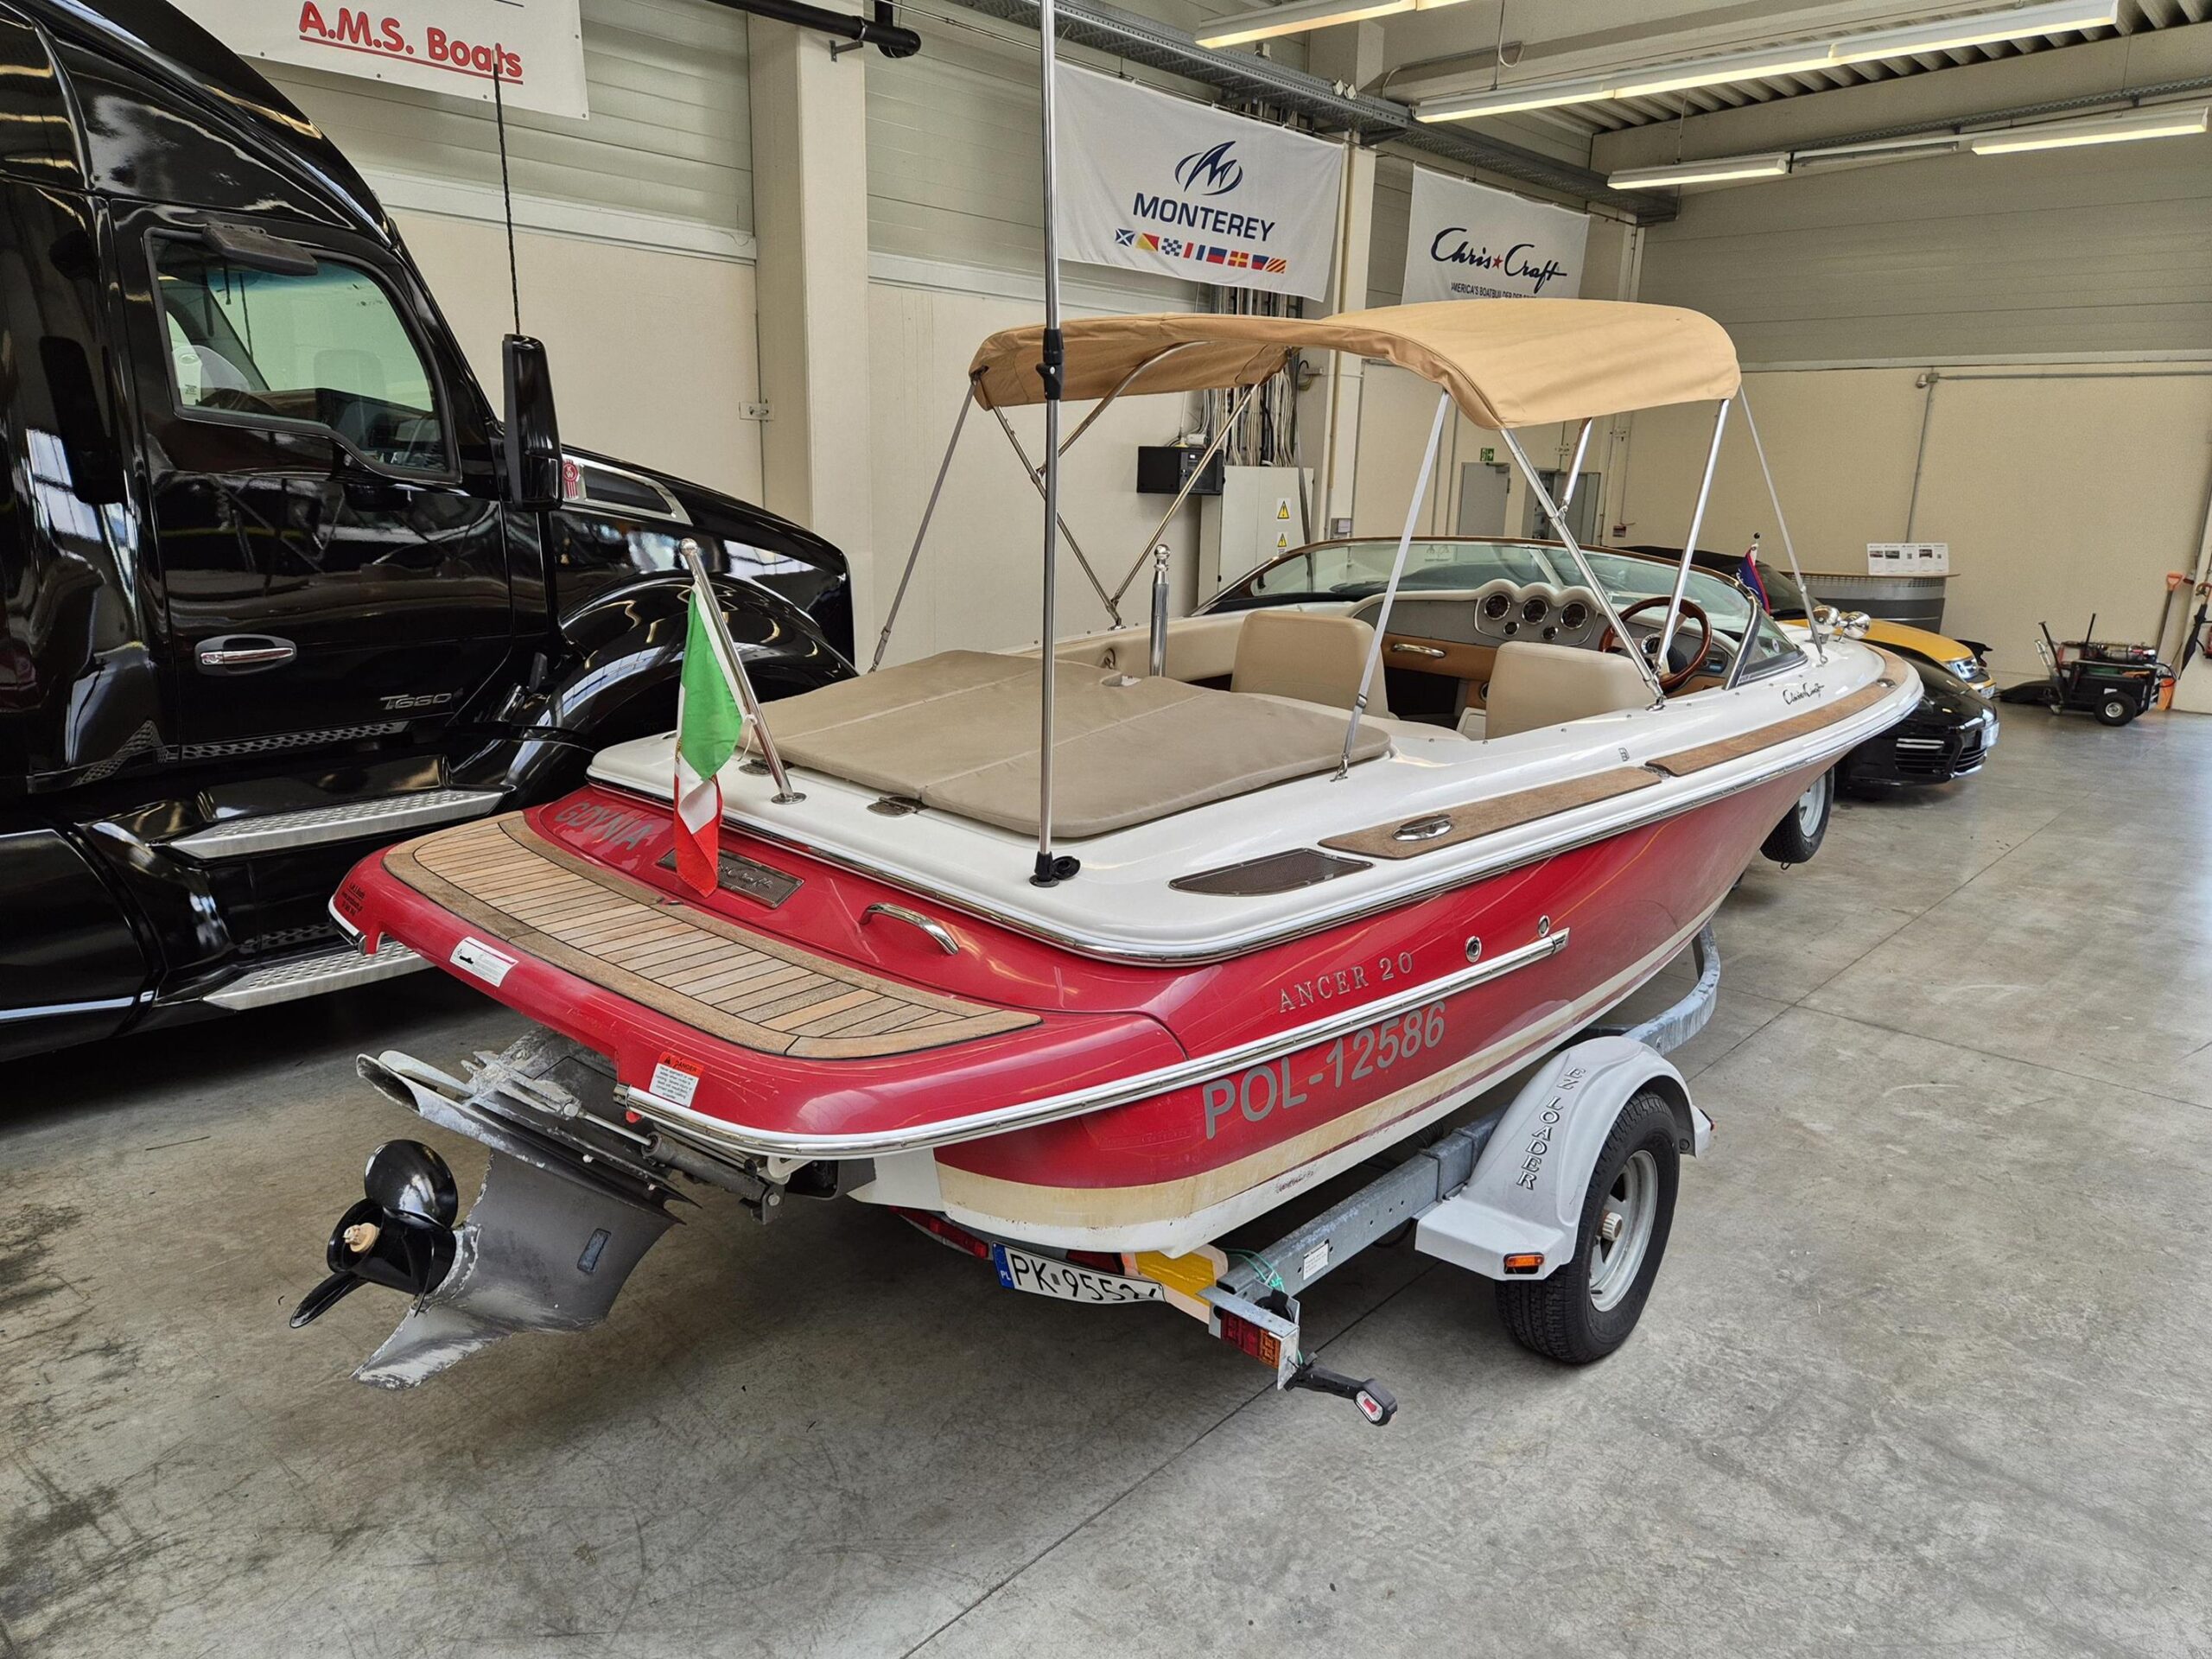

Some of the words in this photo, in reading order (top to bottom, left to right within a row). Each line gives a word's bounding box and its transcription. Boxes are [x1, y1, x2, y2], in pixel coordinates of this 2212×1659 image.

[299, 1, 414, 54] A.M.S.
[427, 27, 523, 78] Boats
[1133, 192, 1275, 242] MONTEREY
[1451, 282, 1479, 296] AMERICA'S
[380, 693, 452, 710] T660
[555, 802, 654, 851] GDYNIA
[1279, 965, 1370, 1014] ANCER
[1379, 950, 1413, 981] 20
[1202, 1001, 1446, 1140] POL-12586
[1556, 1066, 1586, 1090] EZ
[1516, 1095, 1565, 1191] LOADER
[1000, 1270, 1012, 1281] PL
[1010, 1253, 1058, 1294] PK
